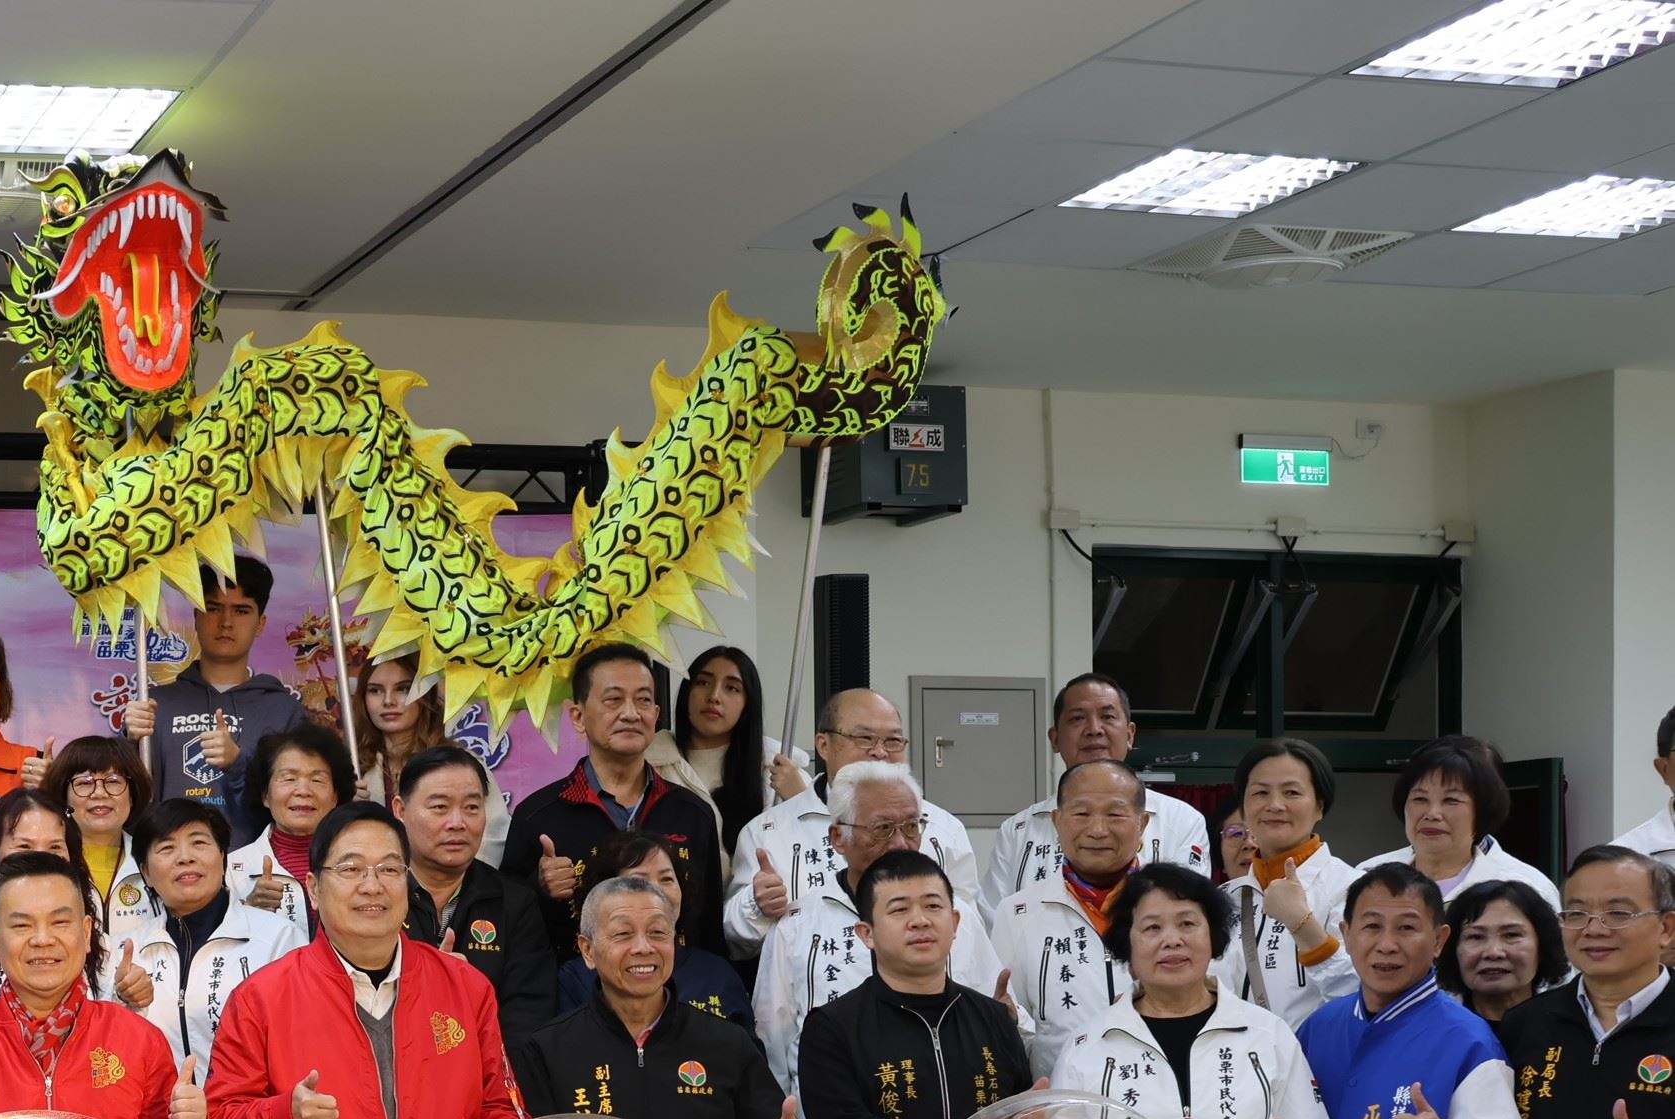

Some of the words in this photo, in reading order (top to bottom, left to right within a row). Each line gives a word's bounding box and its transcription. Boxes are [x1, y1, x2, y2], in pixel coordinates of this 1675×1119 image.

[186, 787, 212, 797] rotary
[200, 796, 226, 805] youth
[843, 926, 857, 965] 理事長
[1074, 926, 1090, 965] 理事長
[1054, 937, 1078, 1010] 賴春木
[901, 1059, 918, 1099] 理事長
[1141, 1051, 1157, 1076] 代表
[1538, 1046, 1563, 1098] 副局長
[595, 1064, 613, 1115] 副主席
